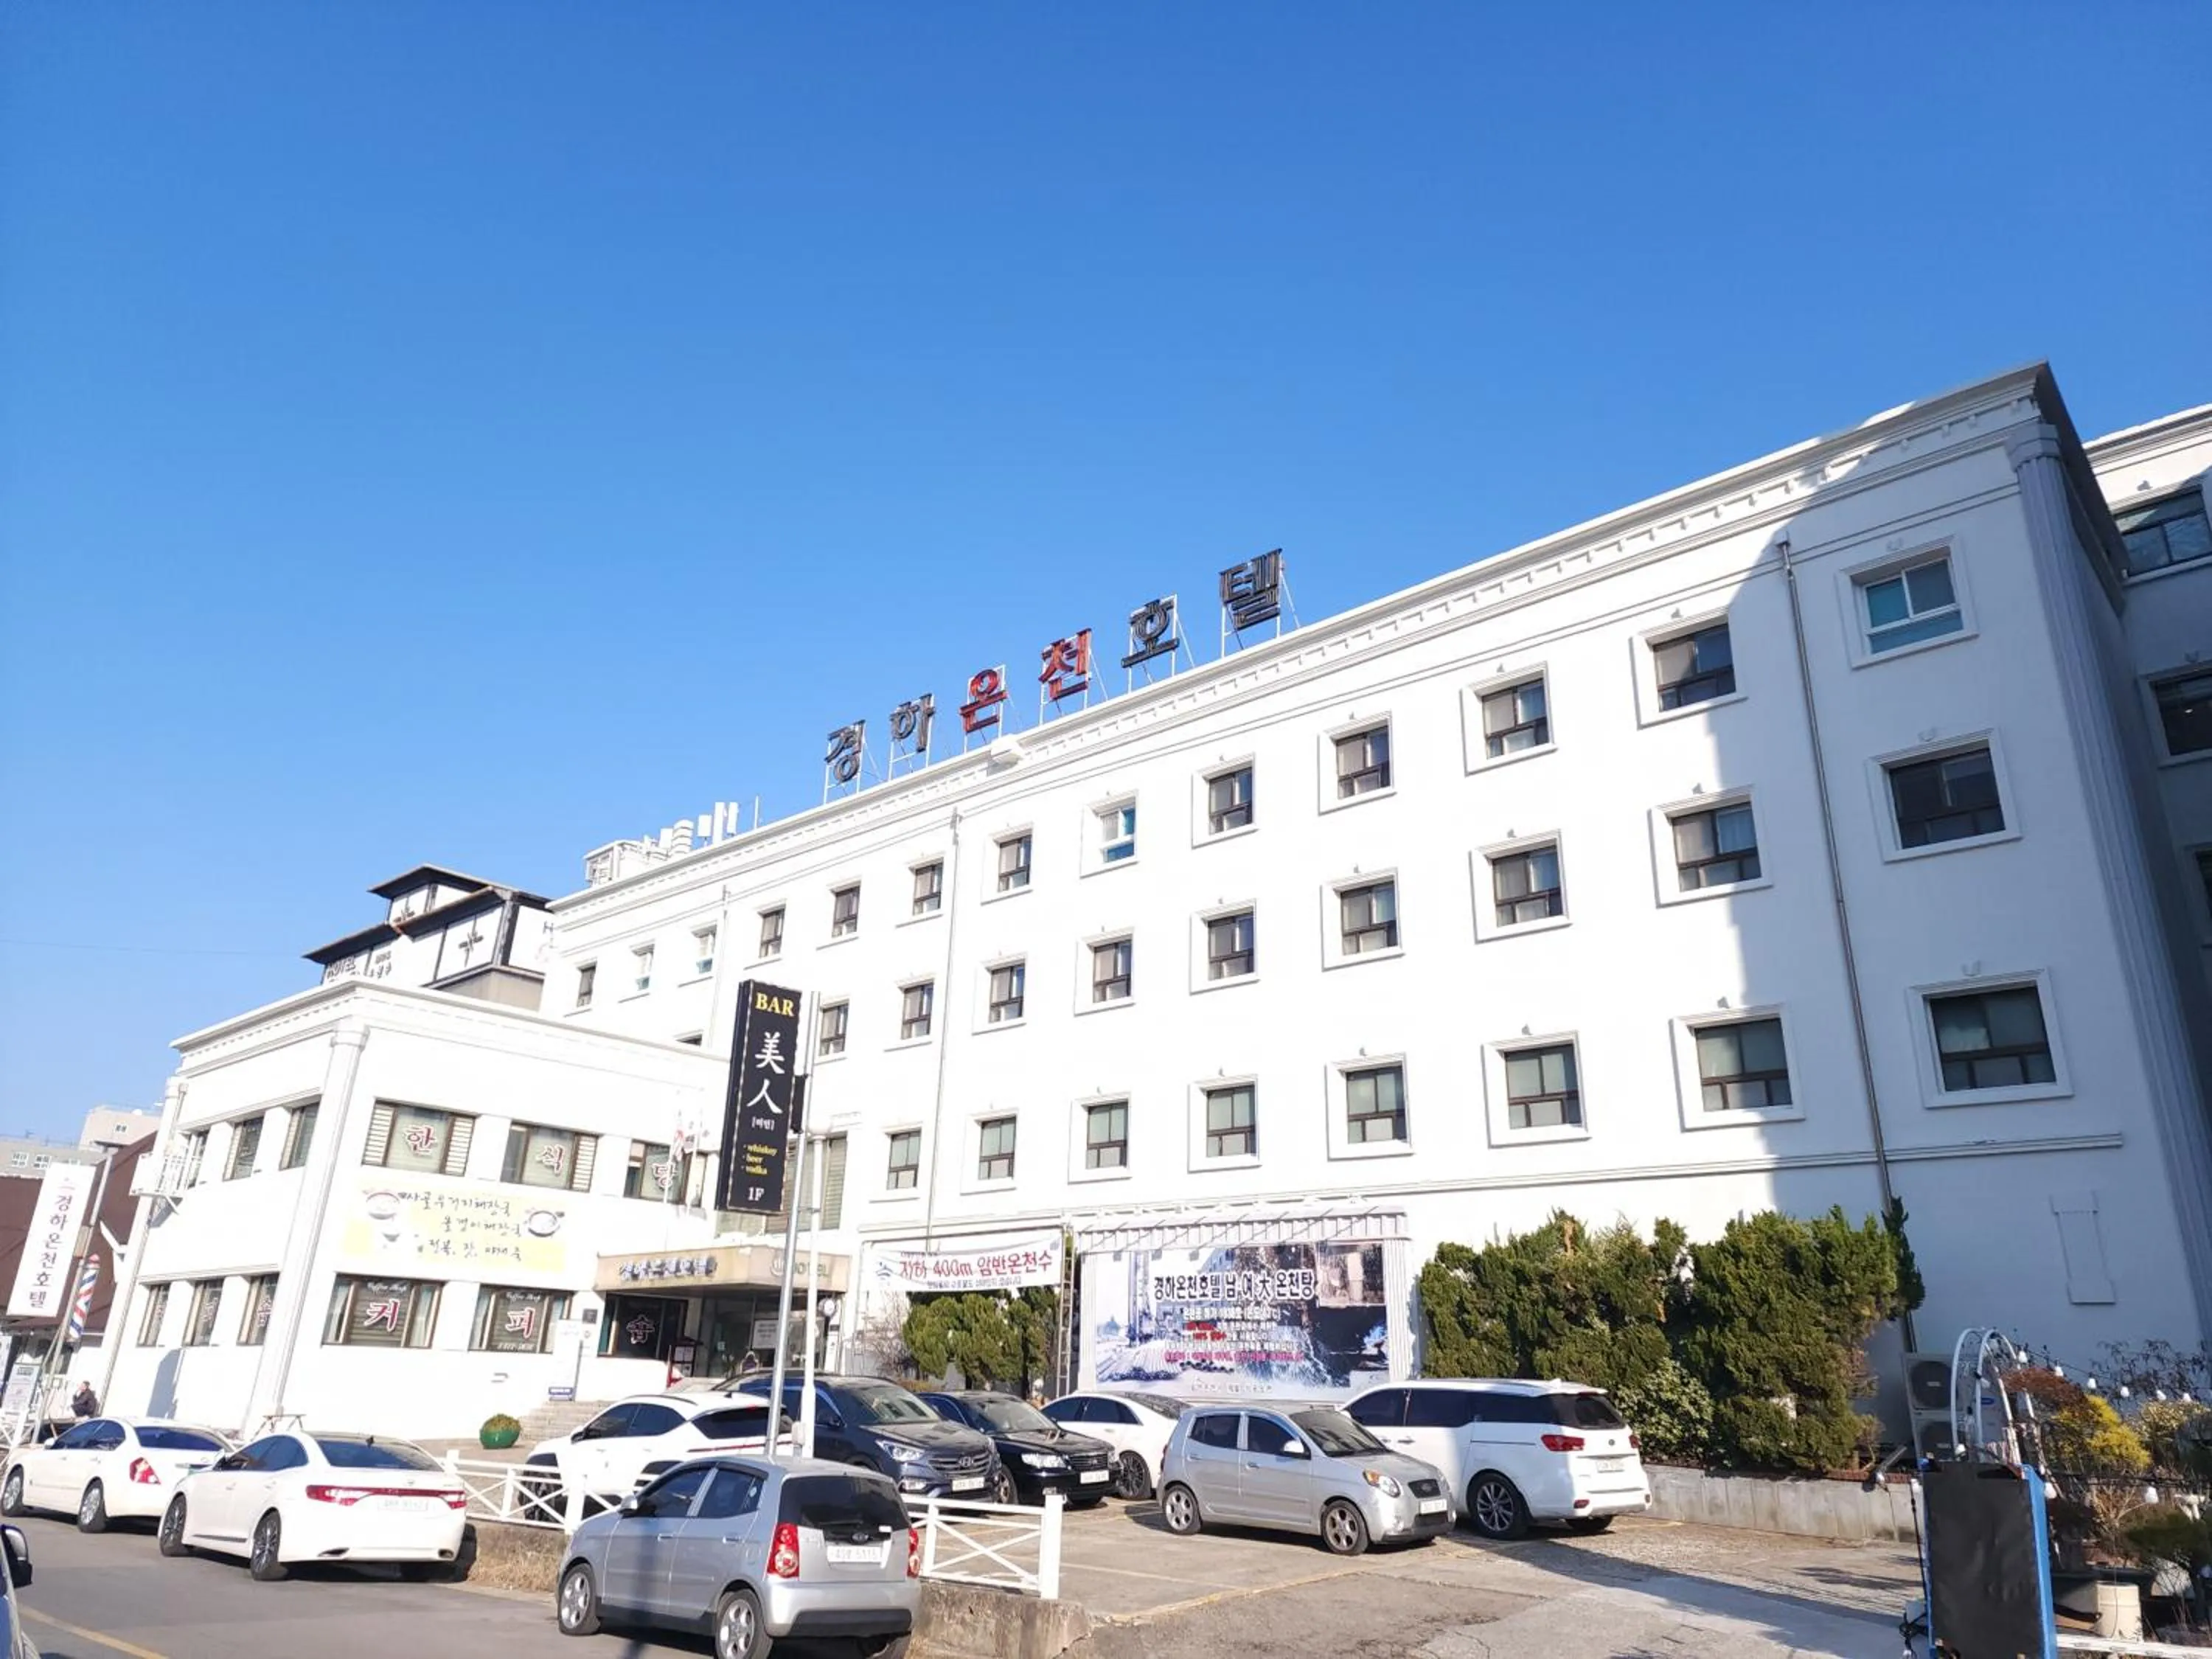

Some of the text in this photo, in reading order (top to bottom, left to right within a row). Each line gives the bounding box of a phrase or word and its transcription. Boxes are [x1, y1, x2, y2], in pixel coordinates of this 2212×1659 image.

[824, 549, 1282, 783] 경하온천호텔
[755, 992, 795, 1017] BAR
[746, 1031, 785, 1114] 美人
[748, 1186, 765, 1201] 1F
[28, 1194, 73, 1310] 경하온천호텔
[899, 1249, 1053, 1281] 지하 400m 암반온천수
[1153, 1274, 1222, 1301] 경하온천호텔
[1276, 1270, 1314, 1299] 온천탕
